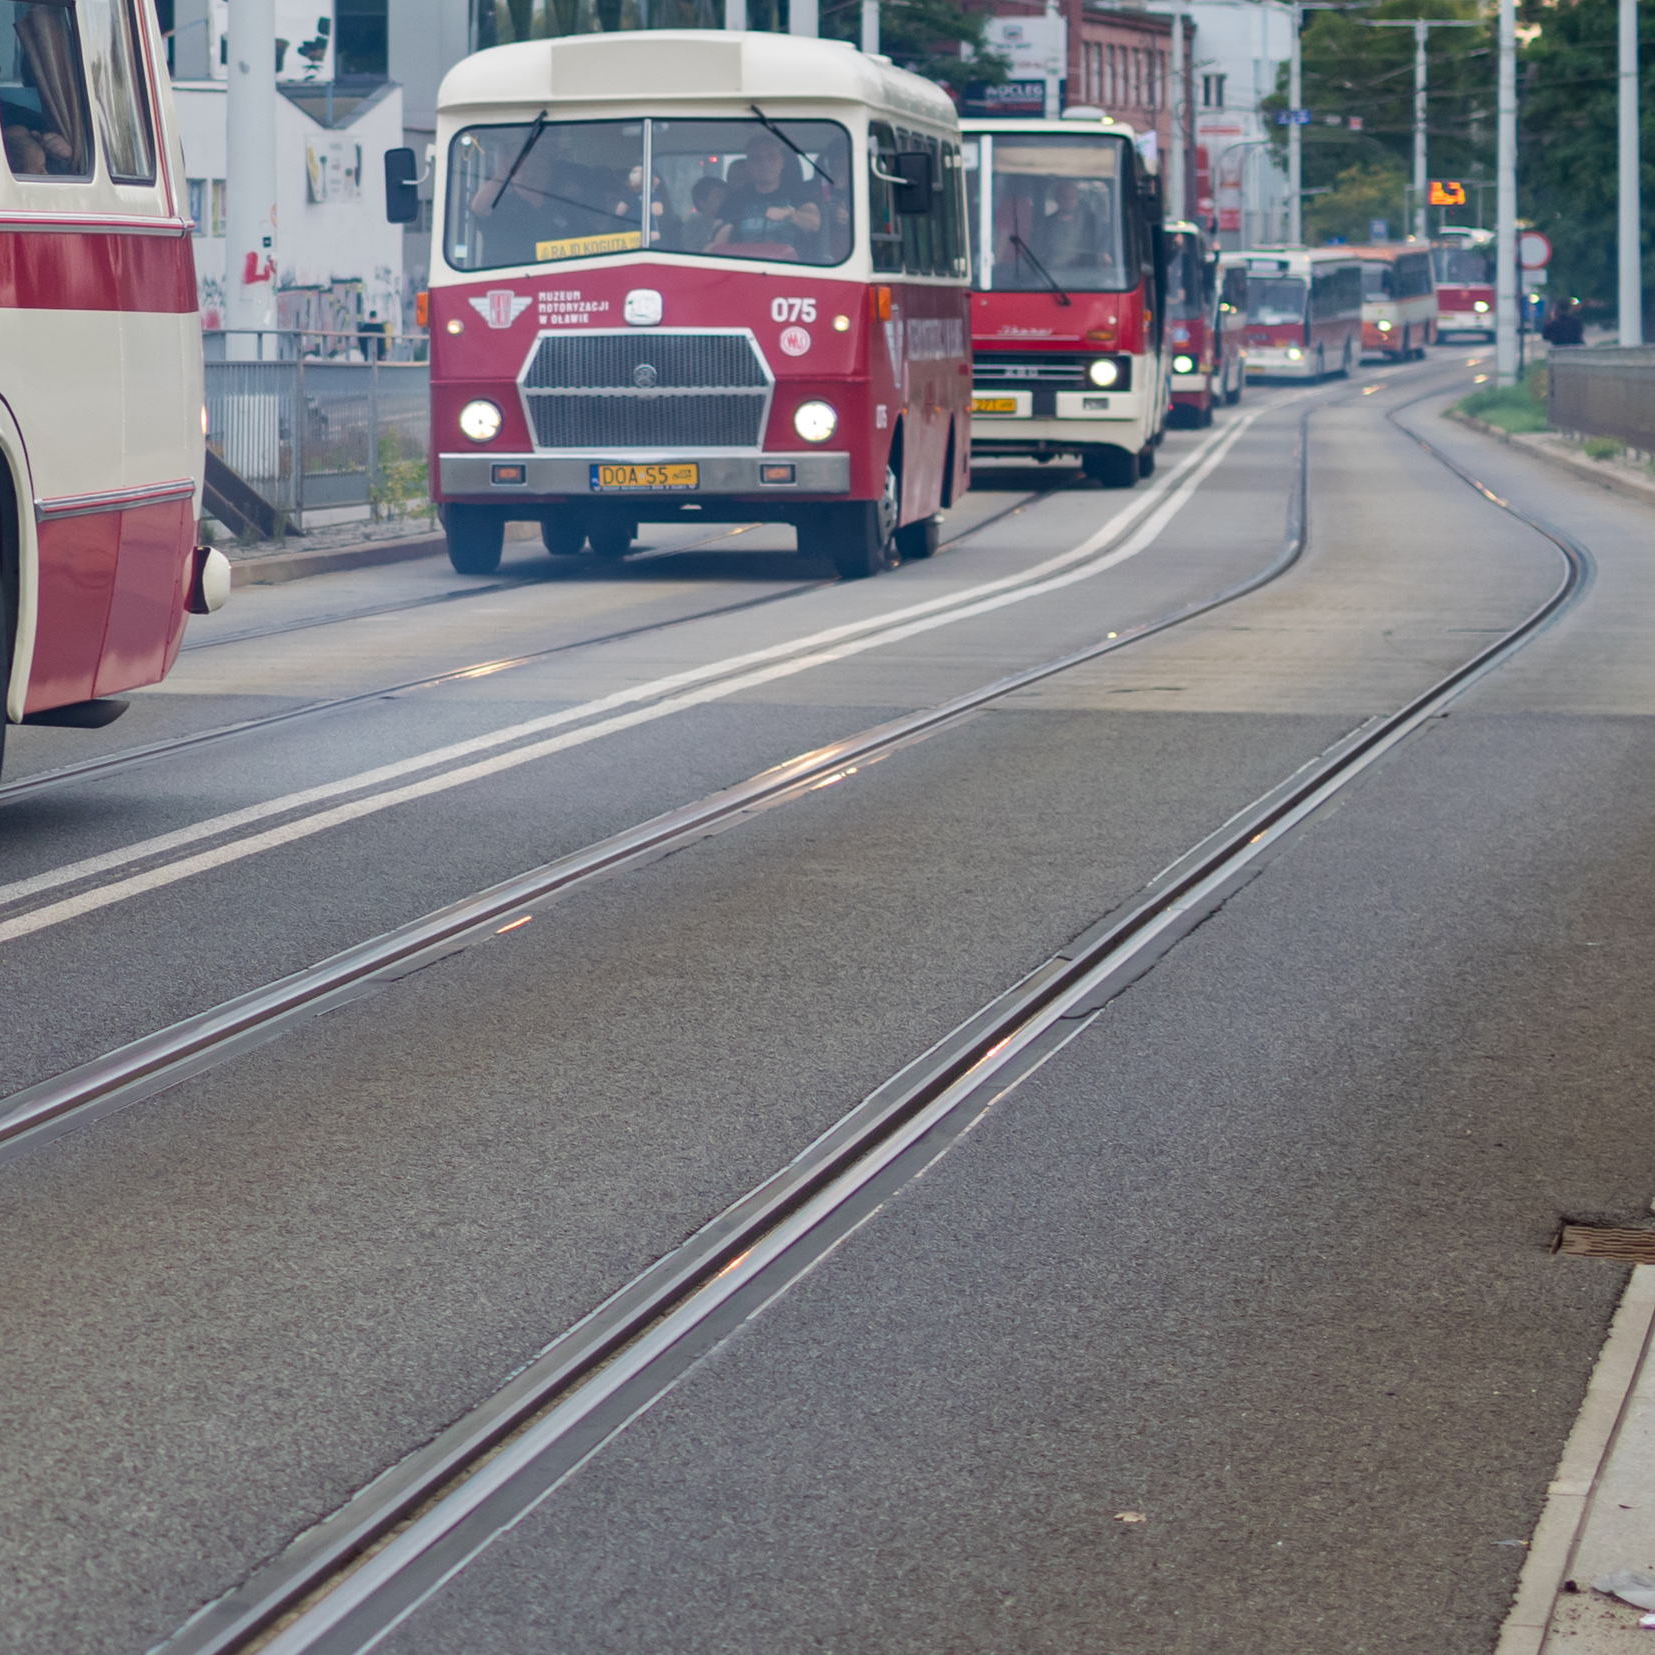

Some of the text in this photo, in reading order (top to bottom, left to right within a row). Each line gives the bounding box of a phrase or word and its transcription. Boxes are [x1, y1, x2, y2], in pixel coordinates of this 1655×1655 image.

[539, 290, 581, 302] MUZEUM
[539, 301, 609, 313] MOTORYZACJI
[771, 297, 817, 323] 075
[539, 313, 589, 324] W OŁAWIE
[602, 466, 639, 485] DOA
